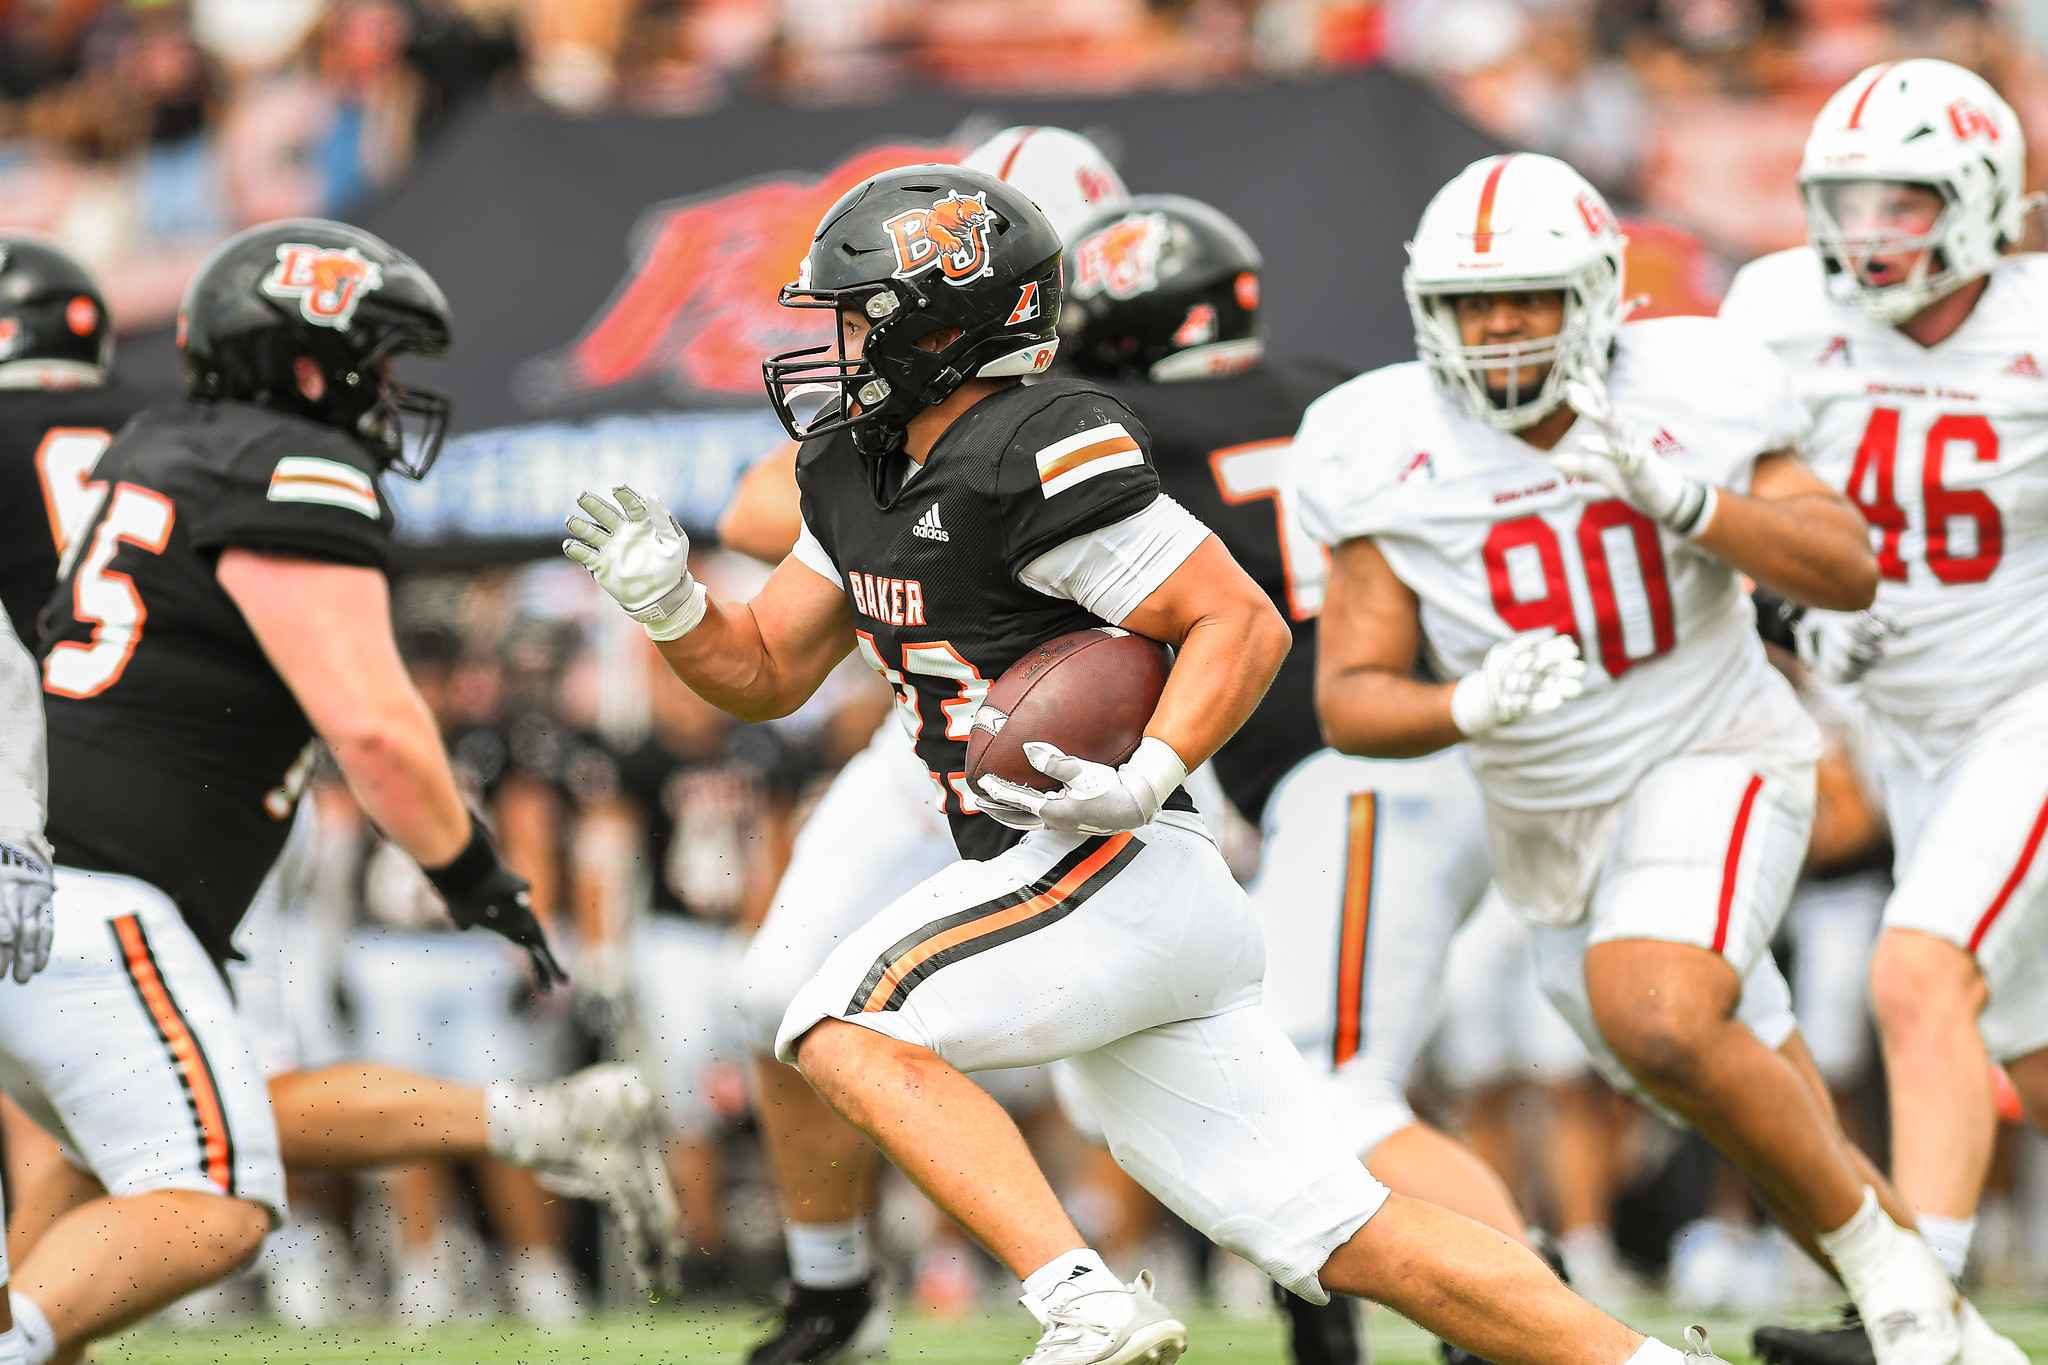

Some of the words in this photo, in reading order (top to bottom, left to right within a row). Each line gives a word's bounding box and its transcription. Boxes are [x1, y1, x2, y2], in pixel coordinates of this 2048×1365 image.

[882, 190, 994, 287] BU
[912, 523, 950, 542] adidas
[1845, 408, 2006, 586] 46
[42, 480, 176, 699] 5
[848, 571, 927, 627] BAKER
[1482, 500, 1676, 679] 90
